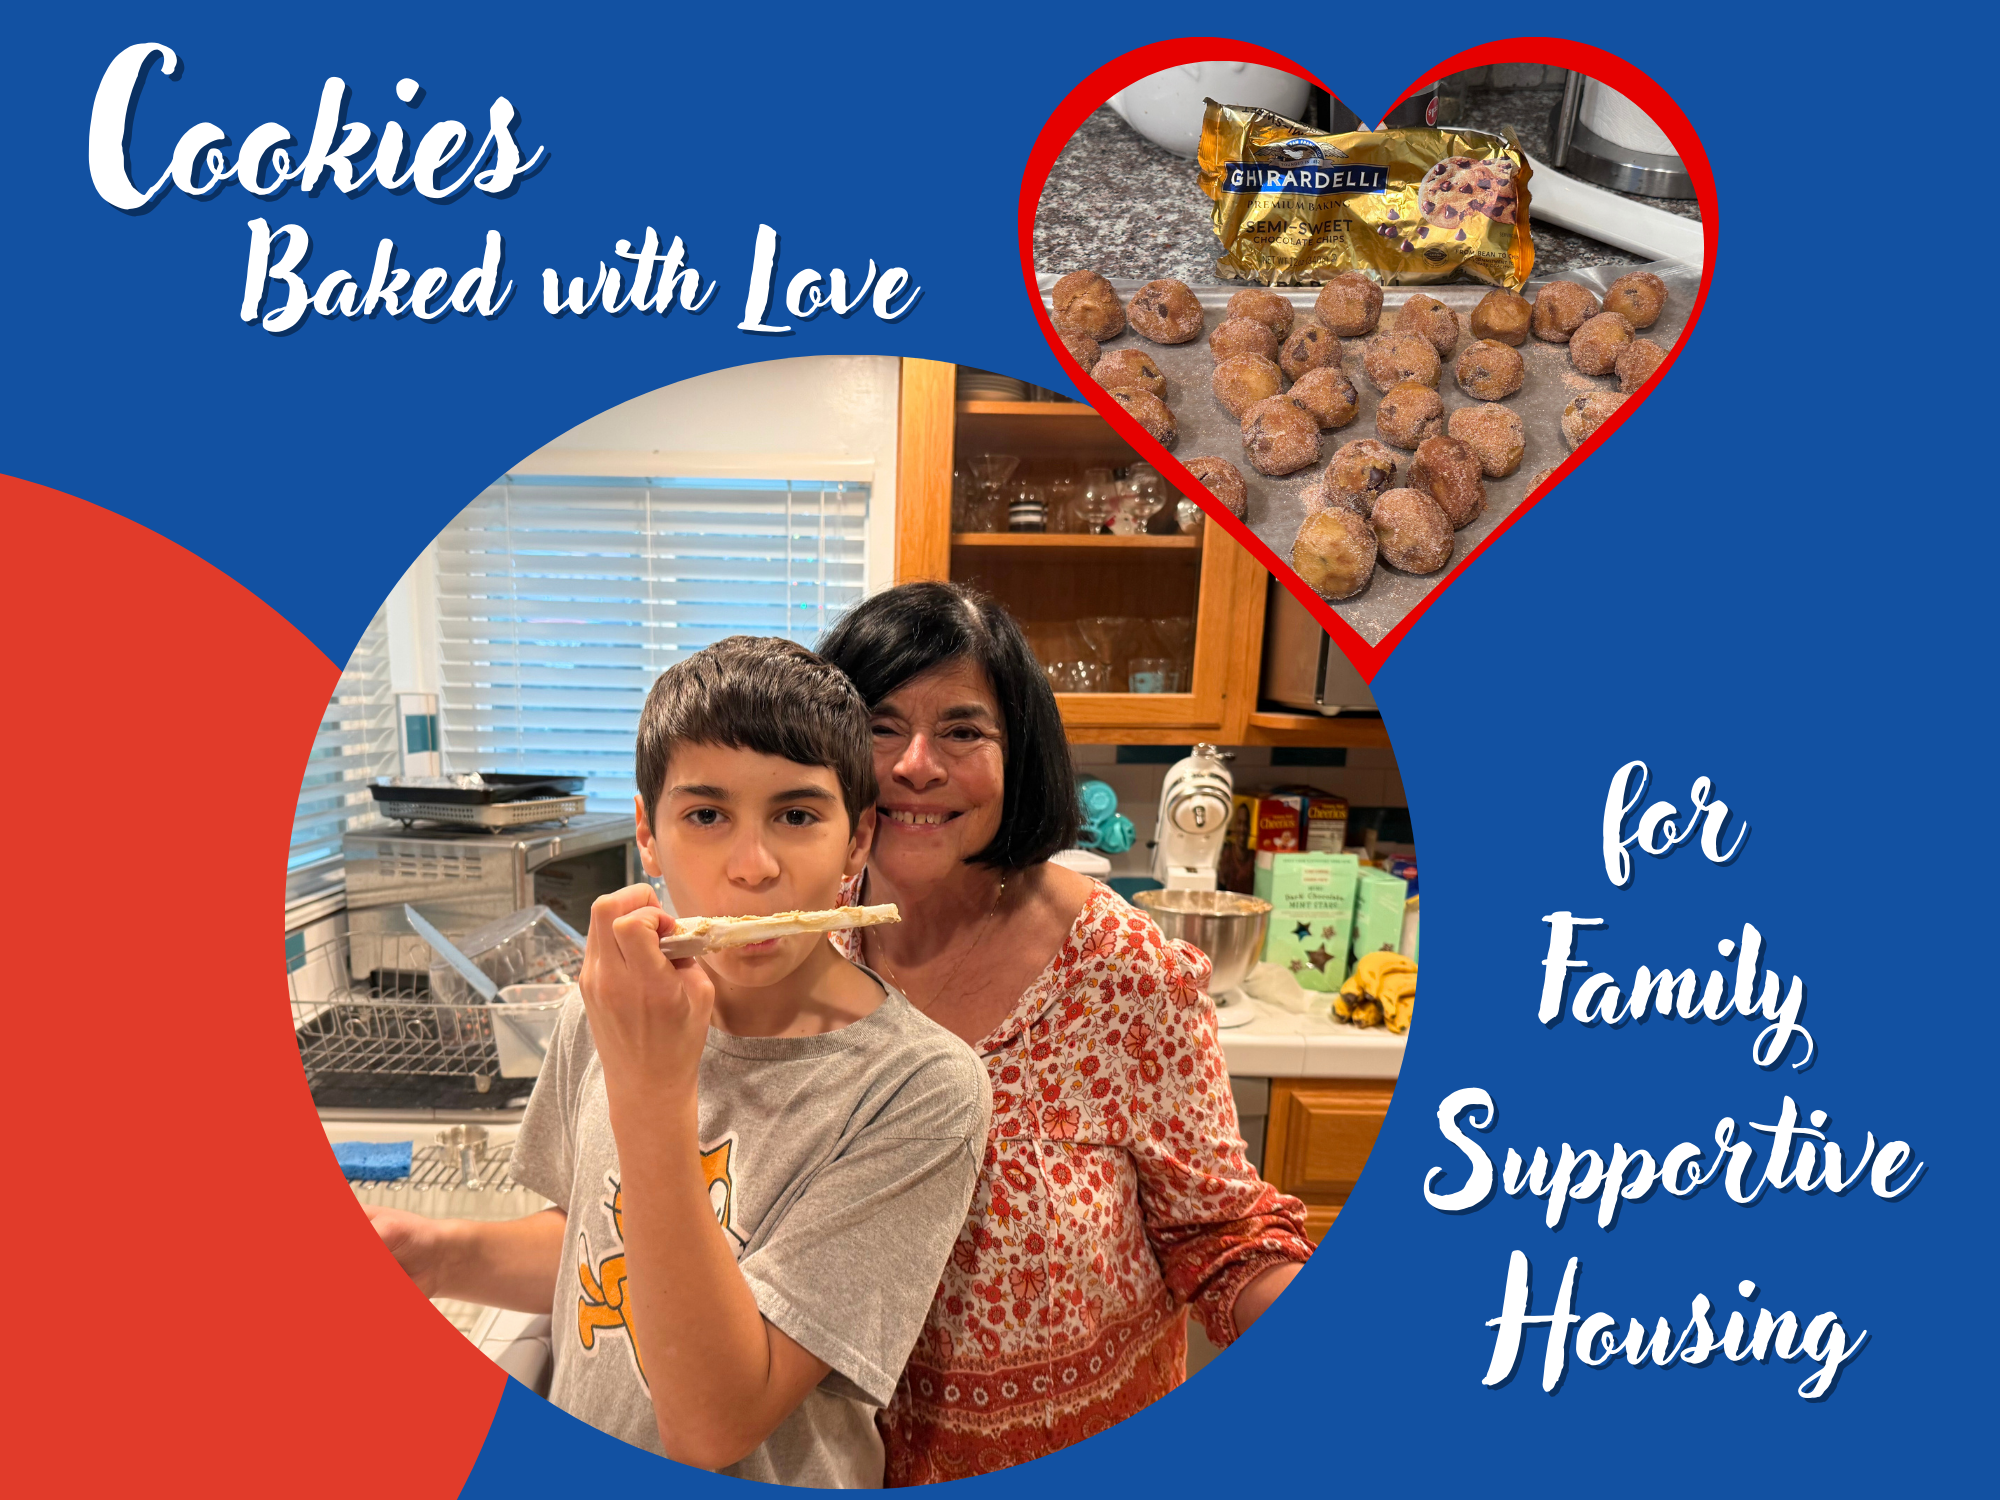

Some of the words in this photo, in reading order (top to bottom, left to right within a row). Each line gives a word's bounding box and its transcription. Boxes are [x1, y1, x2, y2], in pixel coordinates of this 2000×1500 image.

[1231, 169, 1380, 189] GHIRARDELLI
[1247, 200, 1305, 211] PREMIUM
[1308, 200, 1351, 211] BAKING
[1245, 219, 1353, 236] SEMI-SWEET
[1253, 236, 1313, 246] CHOCOLATE
[1315, 235, 1345, 244] CHIPS
[1262, 255, 1276, 265] NET
[1477, 250, 1496, 258] BEAN
[1307, 805, 1347, 820] Cheerios
[1259, 817, 1296, 830] Cheerios
